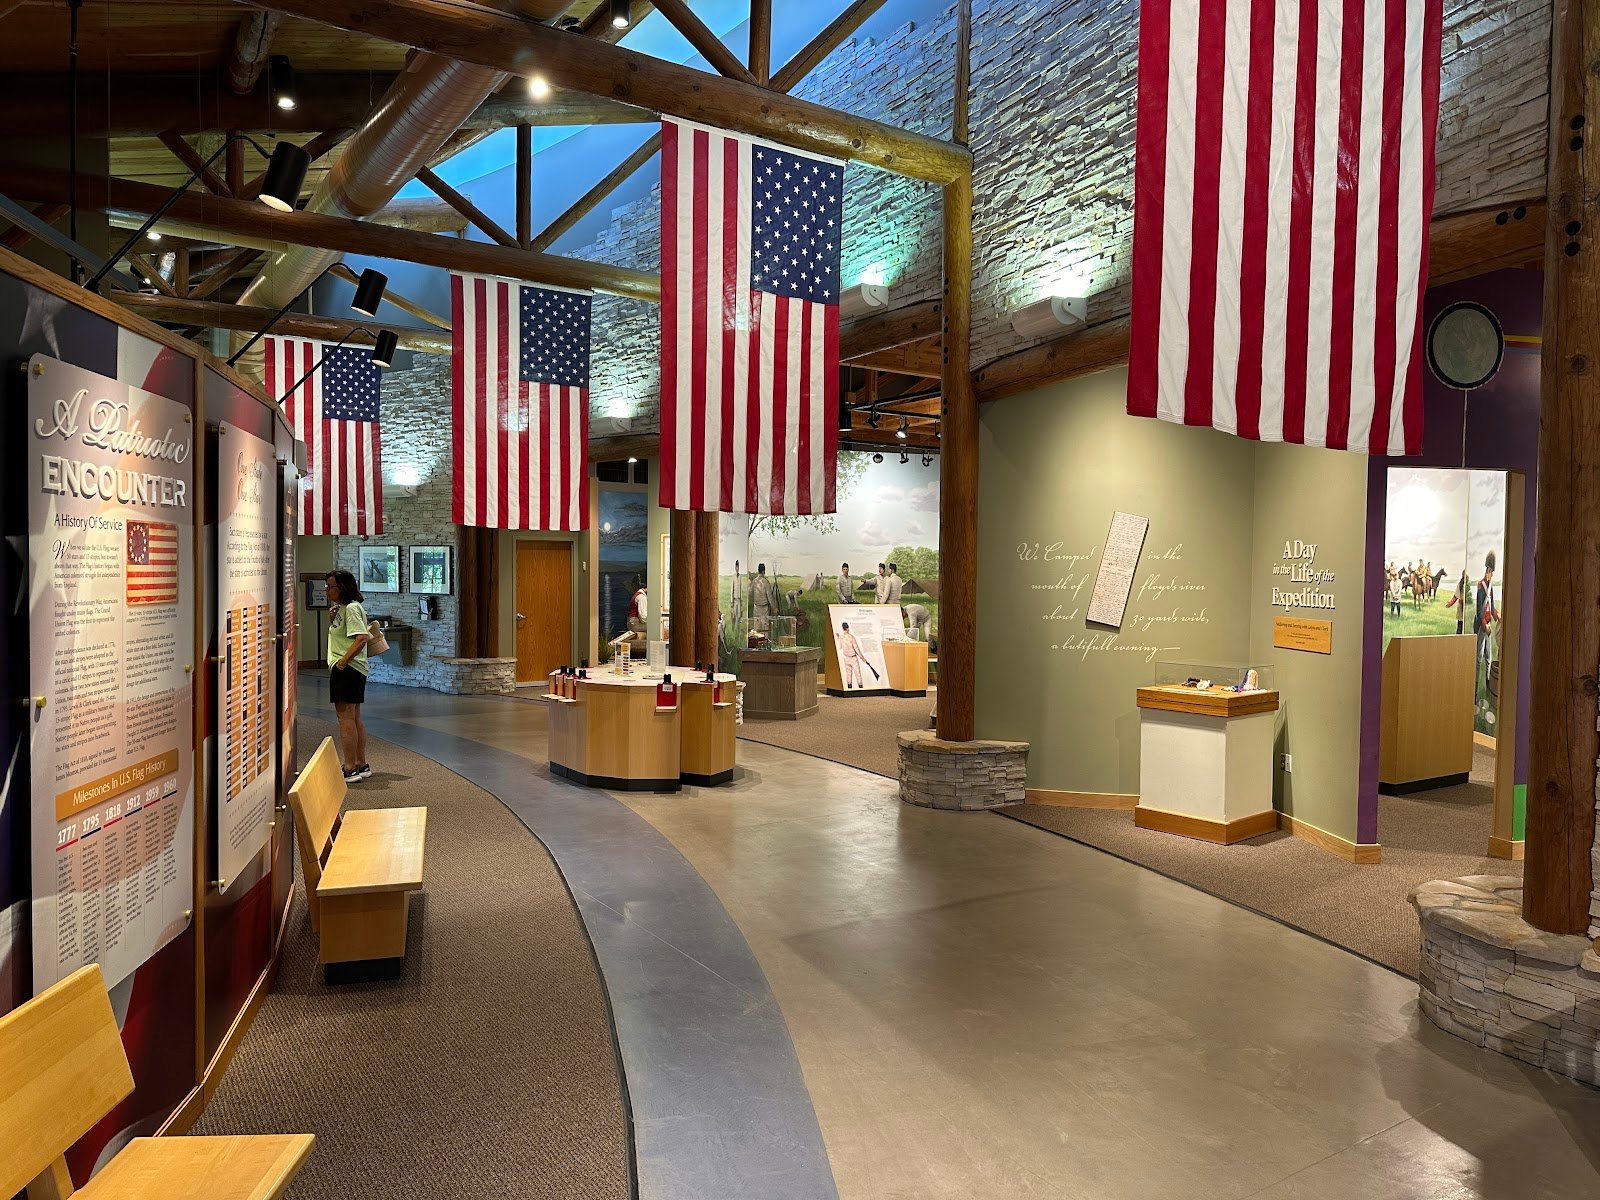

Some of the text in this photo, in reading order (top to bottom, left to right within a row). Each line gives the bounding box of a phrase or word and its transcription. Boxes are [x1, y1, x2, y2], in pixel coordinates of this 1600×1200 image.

[35, 389, 190, 464] A Patriotic
[42, 455, 186, 507] ENCOUNTER
[54, 514, 122, 531] A History Of Service
[1017, 542, 1182, 570] We Camped in the
[1283, 540, 1317, 564] A Day
[1031, 574, 1206, 602] mouth of floyds river
[1273, 563, 1334, 585] in the Life of the
[1272, 587, 1335, 612] Expedition
[1043, 605, 1209, 631] about 30 yards wide,
[73, 760, 165, 806] Milestones In U.S. Flag History
[58, 778, 176, 844] 1777 1795 1818 1912 1959 1960
